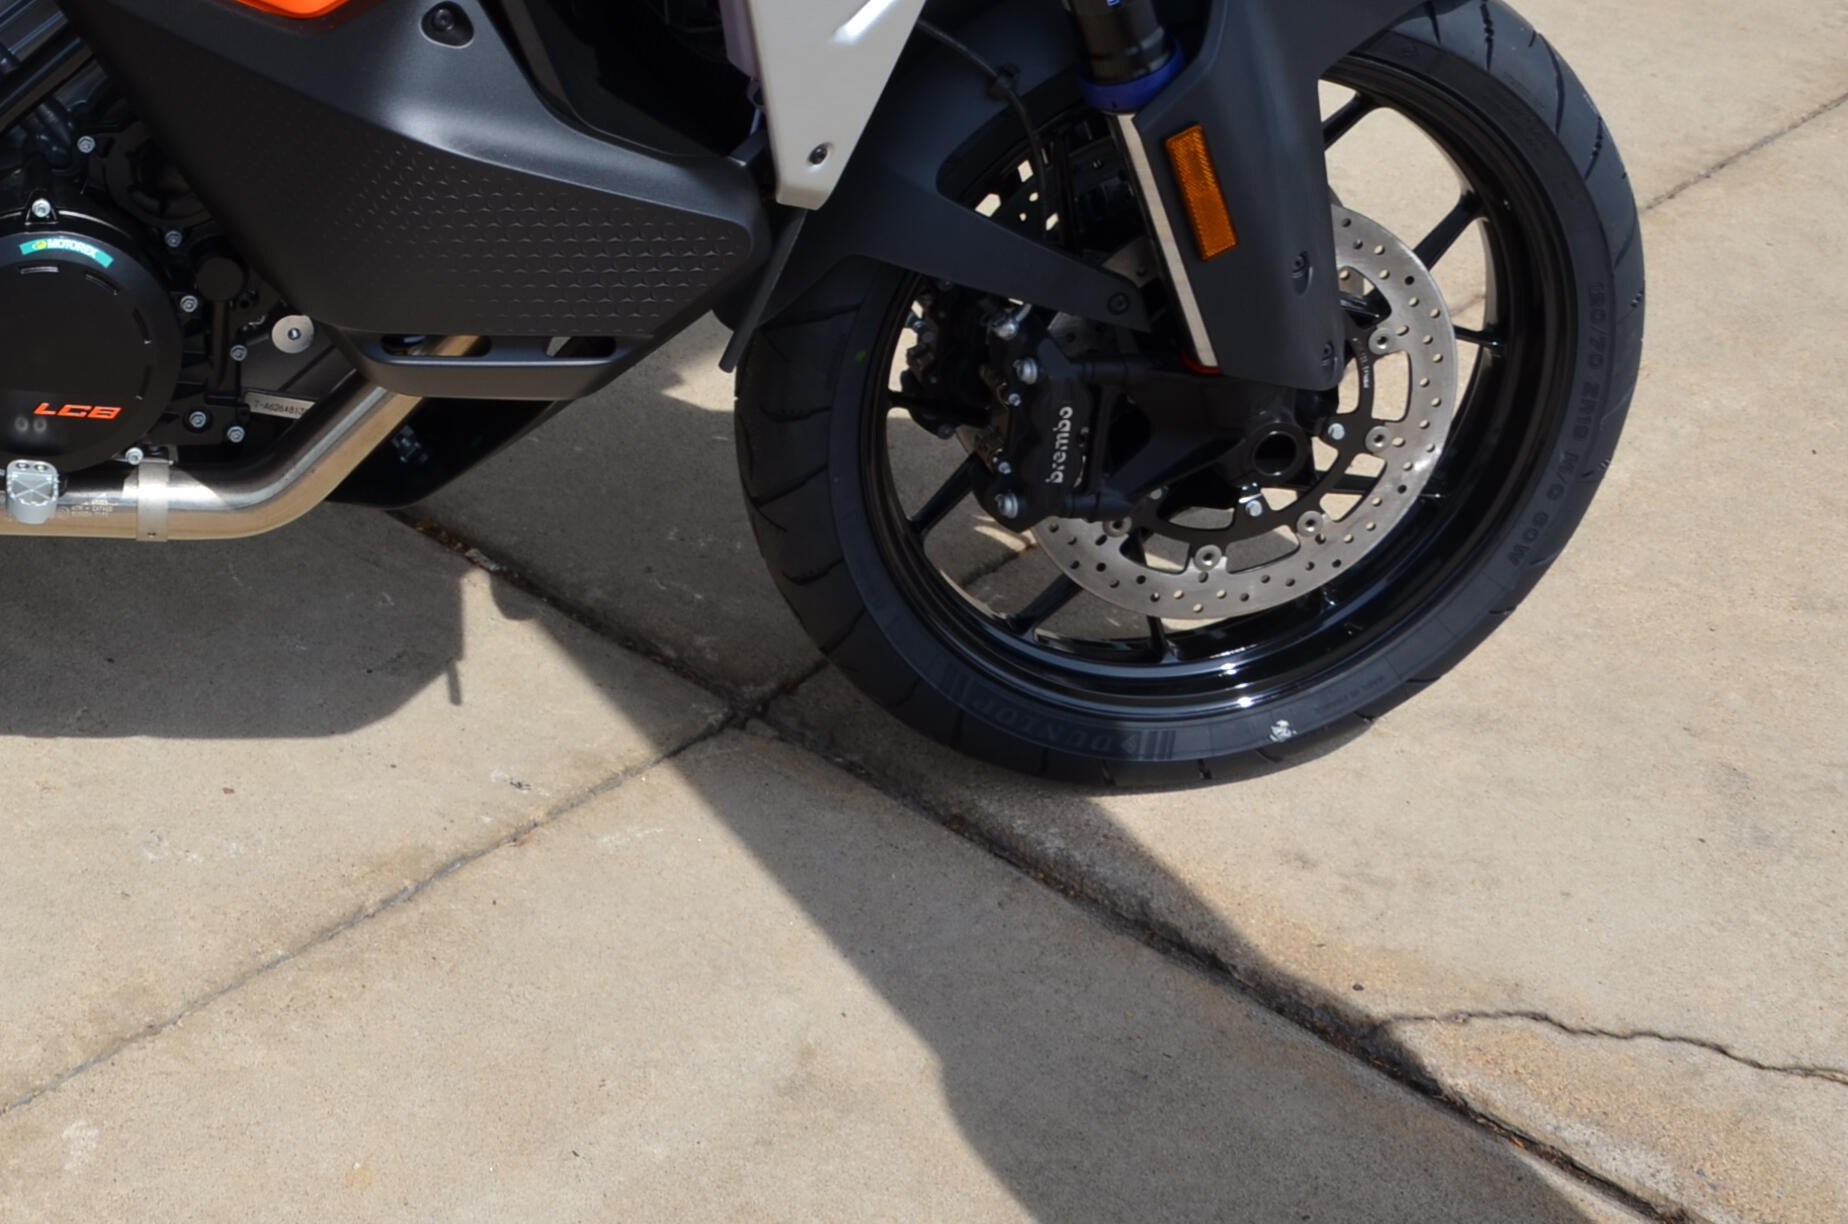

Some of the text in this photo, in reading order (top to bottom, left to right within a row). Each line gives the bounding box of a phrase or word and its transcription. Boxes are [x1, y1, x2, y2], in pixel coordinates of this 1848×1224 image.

[47, 237, 98, 259] MOTOREX
[1044, 406, 1074, 484] brembo
[972, 692, 1115, 753] DUNLOP
